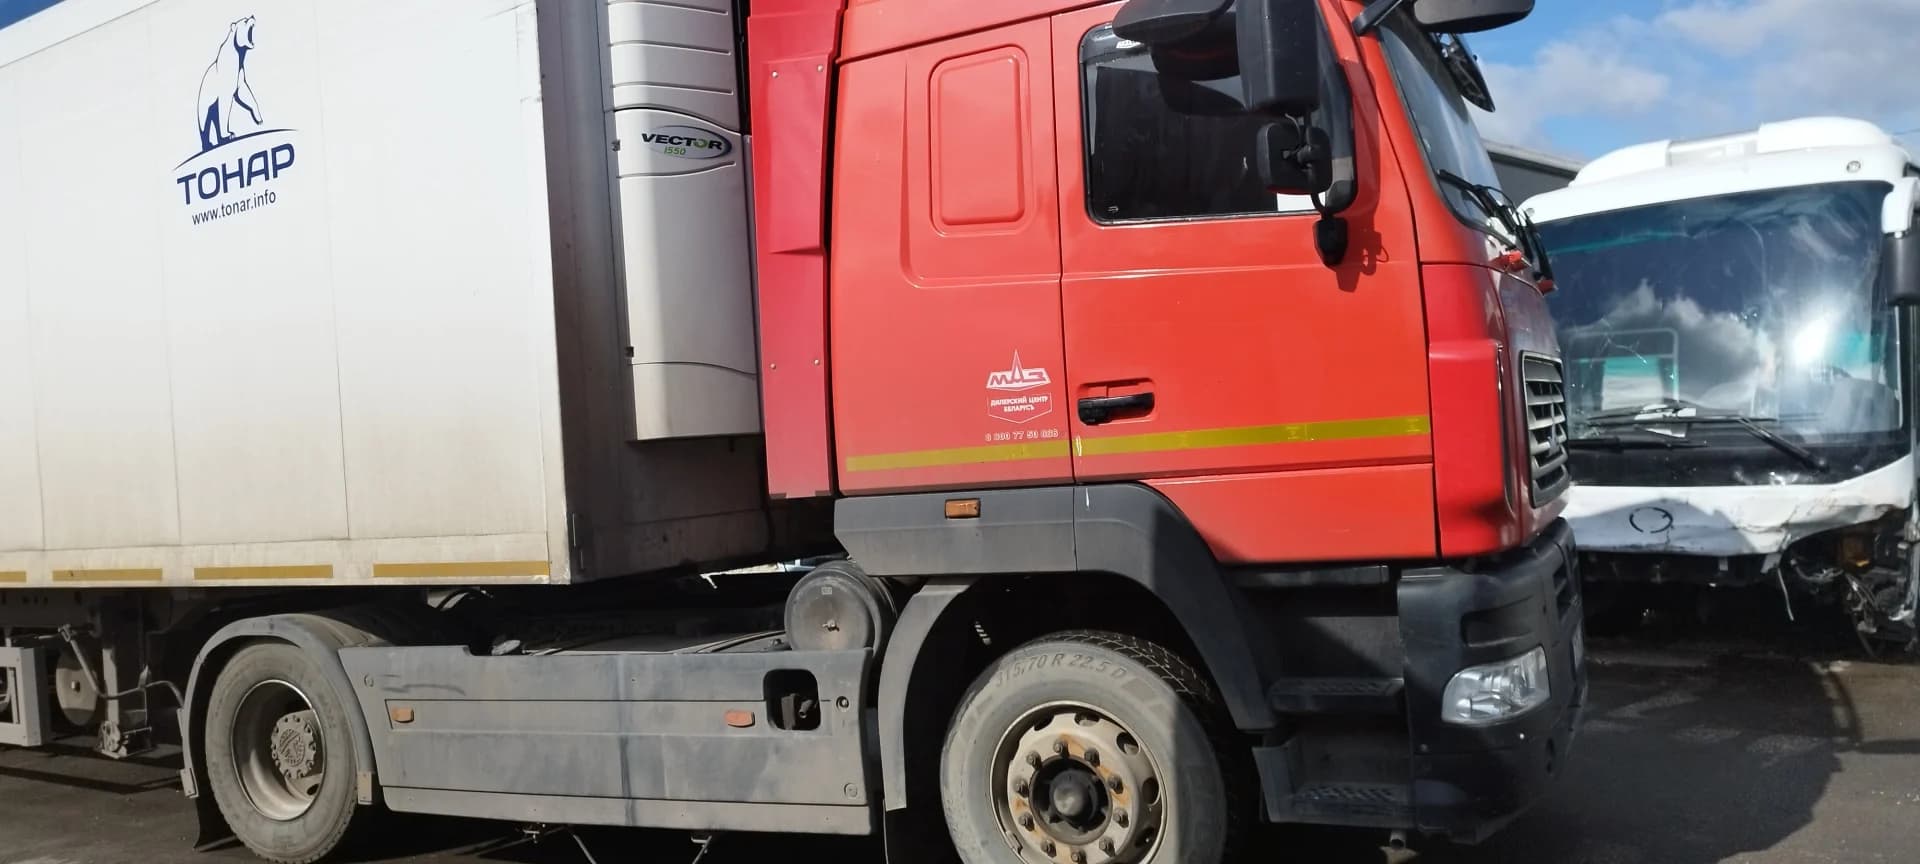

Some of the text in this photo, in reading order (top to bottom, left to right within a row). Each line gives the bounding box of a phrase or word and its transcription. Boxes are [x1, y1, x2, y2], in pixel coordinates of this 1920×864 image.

[641, 133, 723, 151] VECTOR
[176, 143, 295, 206] ТОНАР
[191, 188, 277, 226] www.tonar.info
[1051, 653, 1066, 667] R
[1069, 653, 1113, 674] 22.5
